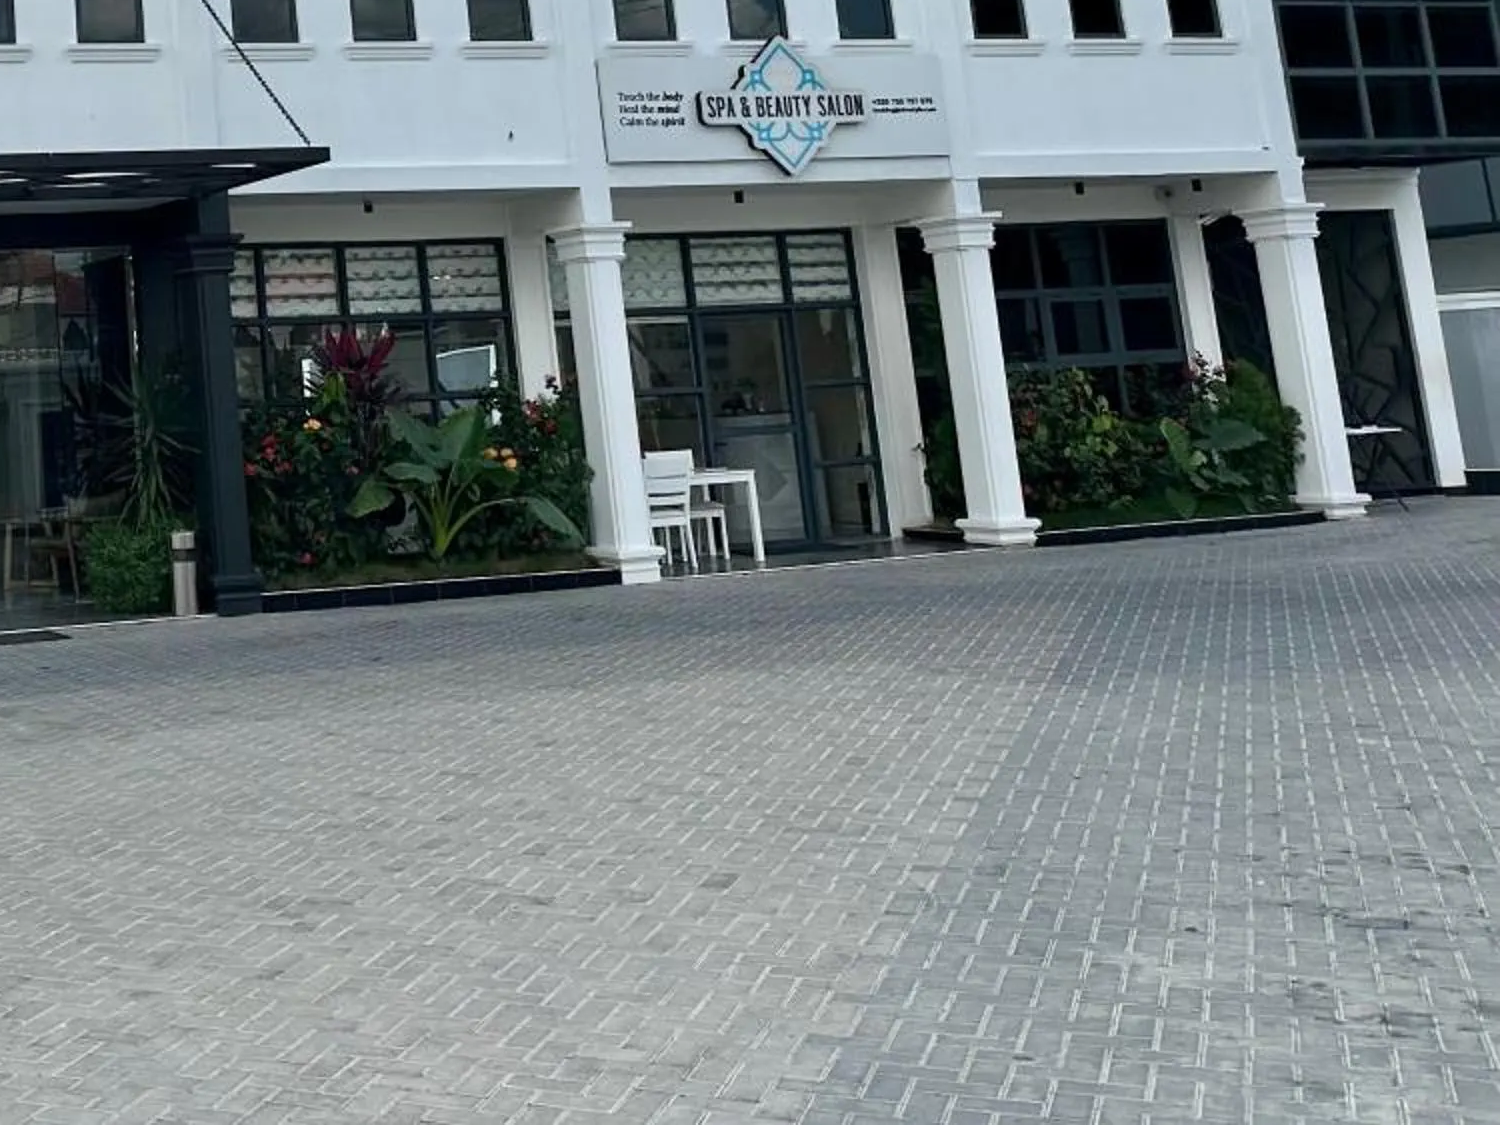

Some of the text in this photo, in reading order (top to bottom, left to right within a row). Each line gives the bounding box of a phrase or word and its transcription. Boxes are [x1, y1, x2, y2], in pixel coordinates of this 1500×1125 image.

[617, 91, 684, 103] Touch the body
[619, 104, 680, 114] Heal the mind
[706, 95, 737, 118] SPA
[740, 96, 752, 118] &
[755, 94, 811, 118] BEAUTY
[817, 93, 865, 117] SALON
[620, 116, 685, 128] Calm the spirit
